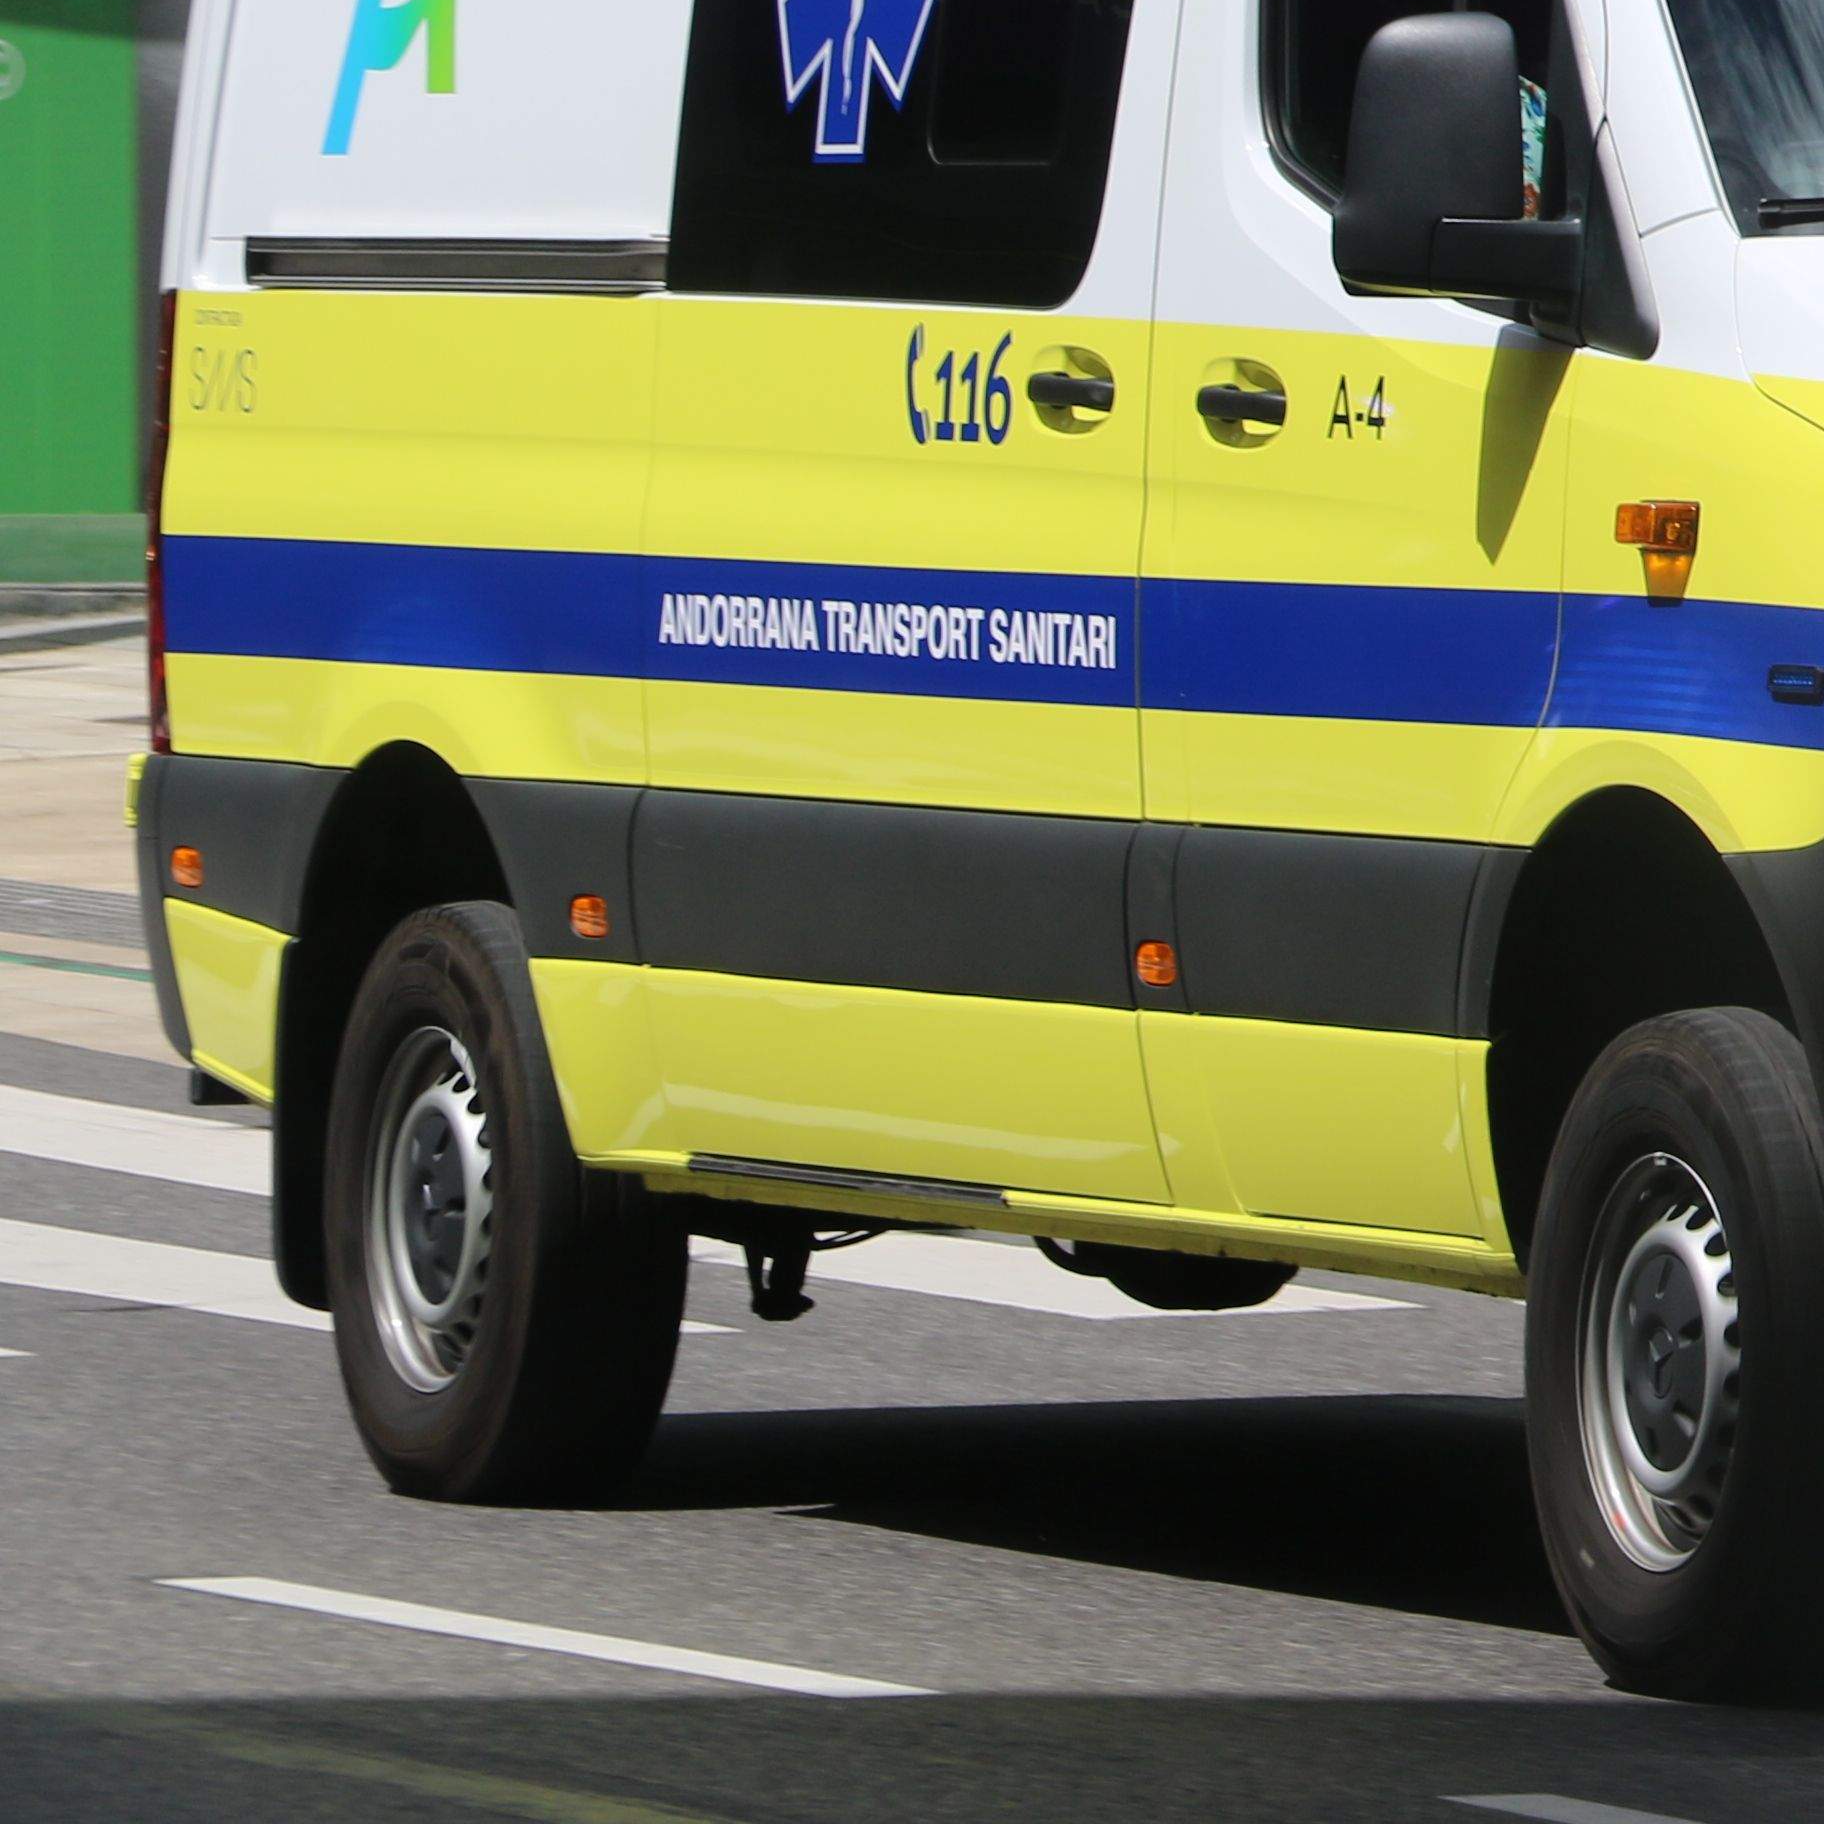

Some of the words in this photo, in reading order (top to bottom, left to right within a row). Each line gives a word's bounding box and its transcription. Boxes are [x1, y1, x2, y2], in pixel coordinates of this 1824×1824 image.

[935, 330, 1013, 445] 116
[1327, 375, 1388, 439] A-4
[659, 593, 820, 651] ANDORRANA
[822, 600, 984, 661] TRANSPORT
[988, 609, 1116, 669] SANITARI
